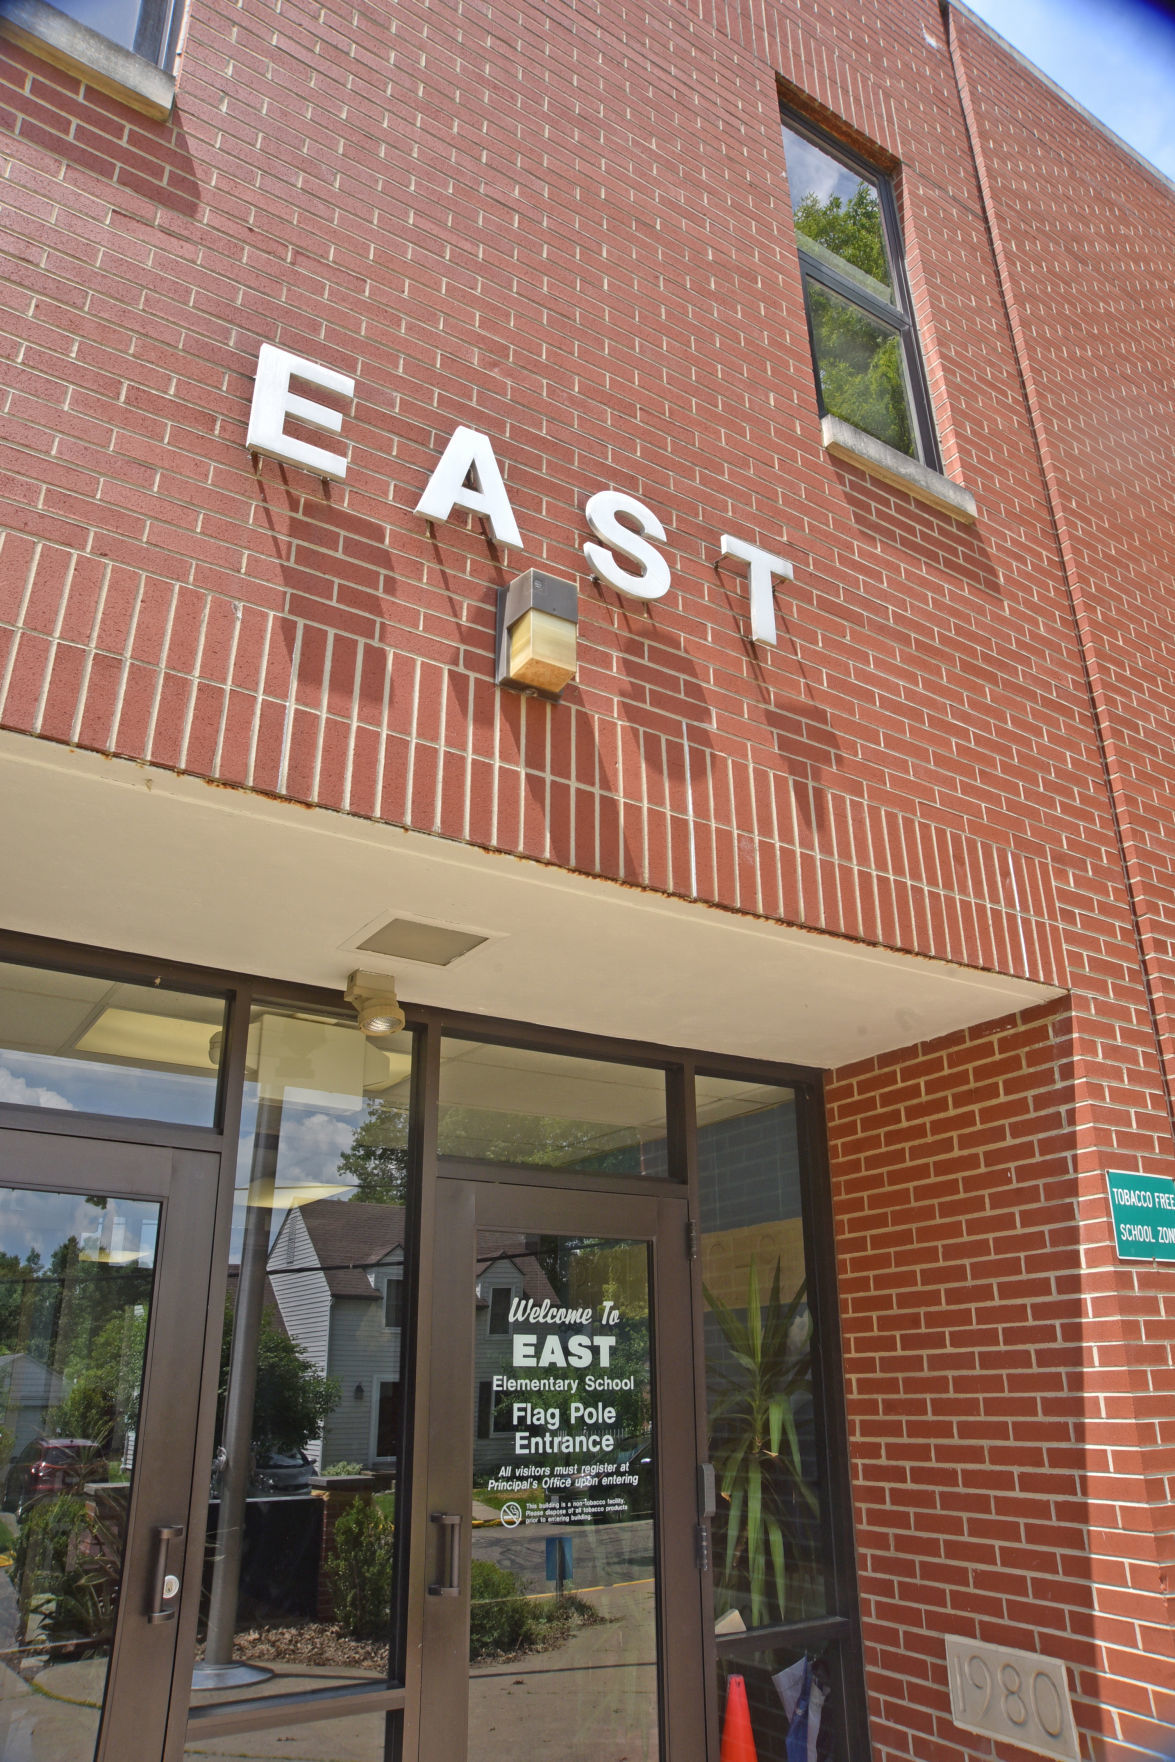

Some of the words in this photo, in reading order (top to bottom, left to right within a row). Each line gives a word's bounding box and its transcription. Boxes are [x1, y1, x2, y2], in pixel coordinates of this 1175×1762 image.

[246, 342, 794, 646] EAST
[1112, 1188, 1153, 1208] TOBACCO
[1154, 1193, 1175, 1210] FREE
[1120, 1224, 1156, 1243] SCHOOL
[1157, 1227, 1175, 1244] ZON
[508, 1297, 592, 1325] Welcome
[601, 1301, 620, 1325] To
[512, 1334, 616, 1368] EAST
[492, 1375, 578, 1394] Elementary
[585, 1375, 634, 1391] School
[512, 1402, 560, 1430] Flag
[570, 1402, 616, 1425] Pole
[515, 1431, 614, 1454] Entrance
[498, 1465, 512, 1477] All
[515, 1465, 550, 1477] visitors
[554, 1464, 578, 1475] must
[581, 1462, 617, 1477] register
[620, 1461, 630, 1472] at
[488, 1478, 538, 1492] Principal's
[542, 1476, 572, 1489] Office
[575, 1475, 598, 1489] upon
[602, 1473, 639, 1486] entering
[539, 1501, 559, 1509] building
[573, 1499, 606, 1507] non-tobacco
[605, 1504, 628, 1512] products
[548, 1515, 569, 1523] entering
[953, 1654, 1063, 1739] 1980
